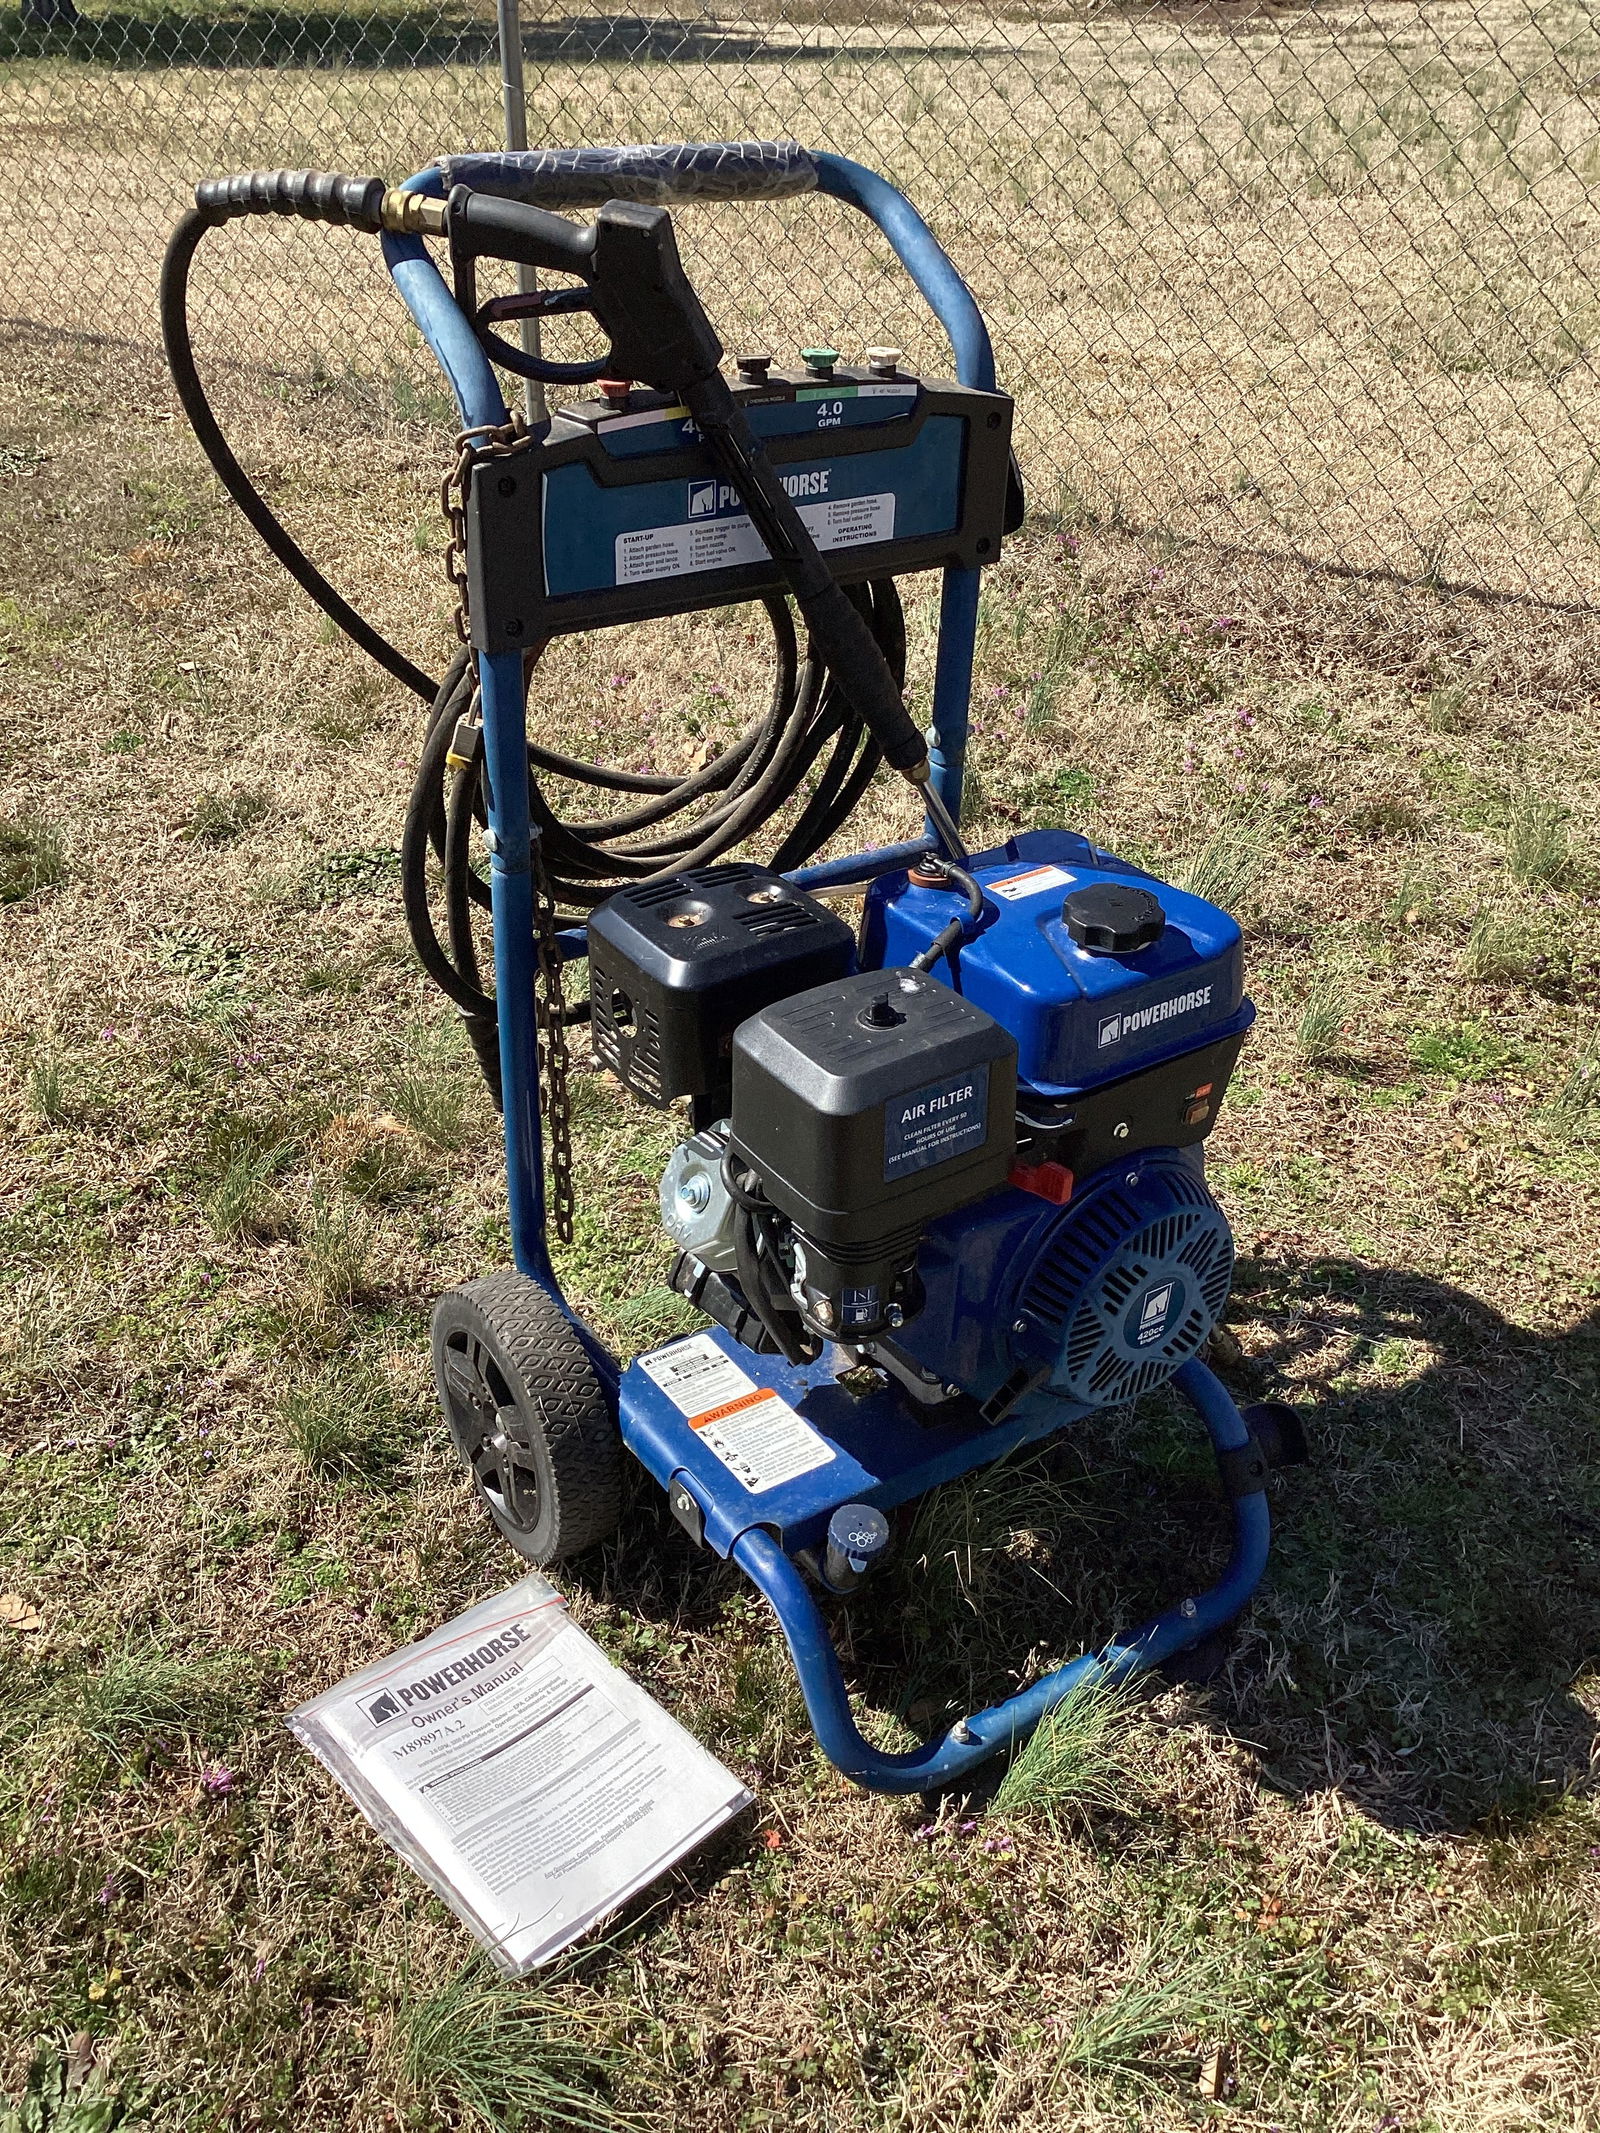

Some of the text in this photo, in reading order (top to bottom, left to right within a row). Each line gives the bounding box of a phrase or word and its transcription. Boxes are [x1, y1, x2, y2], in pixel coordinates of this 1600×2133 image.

[817, 401, 843, 417] 4.0
[818, 417, 841, 427] GPM
[719, 471, 829, 509] POORSE
[623, 534, 654, 544] START-UP
[833, 531, 877, 543] INSTRUCTIONS
[838, 524, 872, 534] OPERATING
[1122, 986, 1211, 1035] POWERHORSE
[901, 1086, 973, 1123] AIR FILTER
[904, 1130, 923, 1140] CLEAN
[923, 1123, 941, 1134] FILTER
[942, 1115, 959, 1127] EVERY
[916, 1133, 936, 1145] HOURS
[945, 1125, 956, 1133] USE
[888, 1122, 982, 1165] (SEE MANUAL FOR INSTRUCTIONS)
[1137, 1325, 1165, 1340] 420cc
[710, 1394, 762, 1420] WARNING
[397, 1623, 531, 1707] POWERHORSE
[411, 1661, 524, 1728] Owner's Manual
[393, 1719, 466, 1761] M89897A.2
